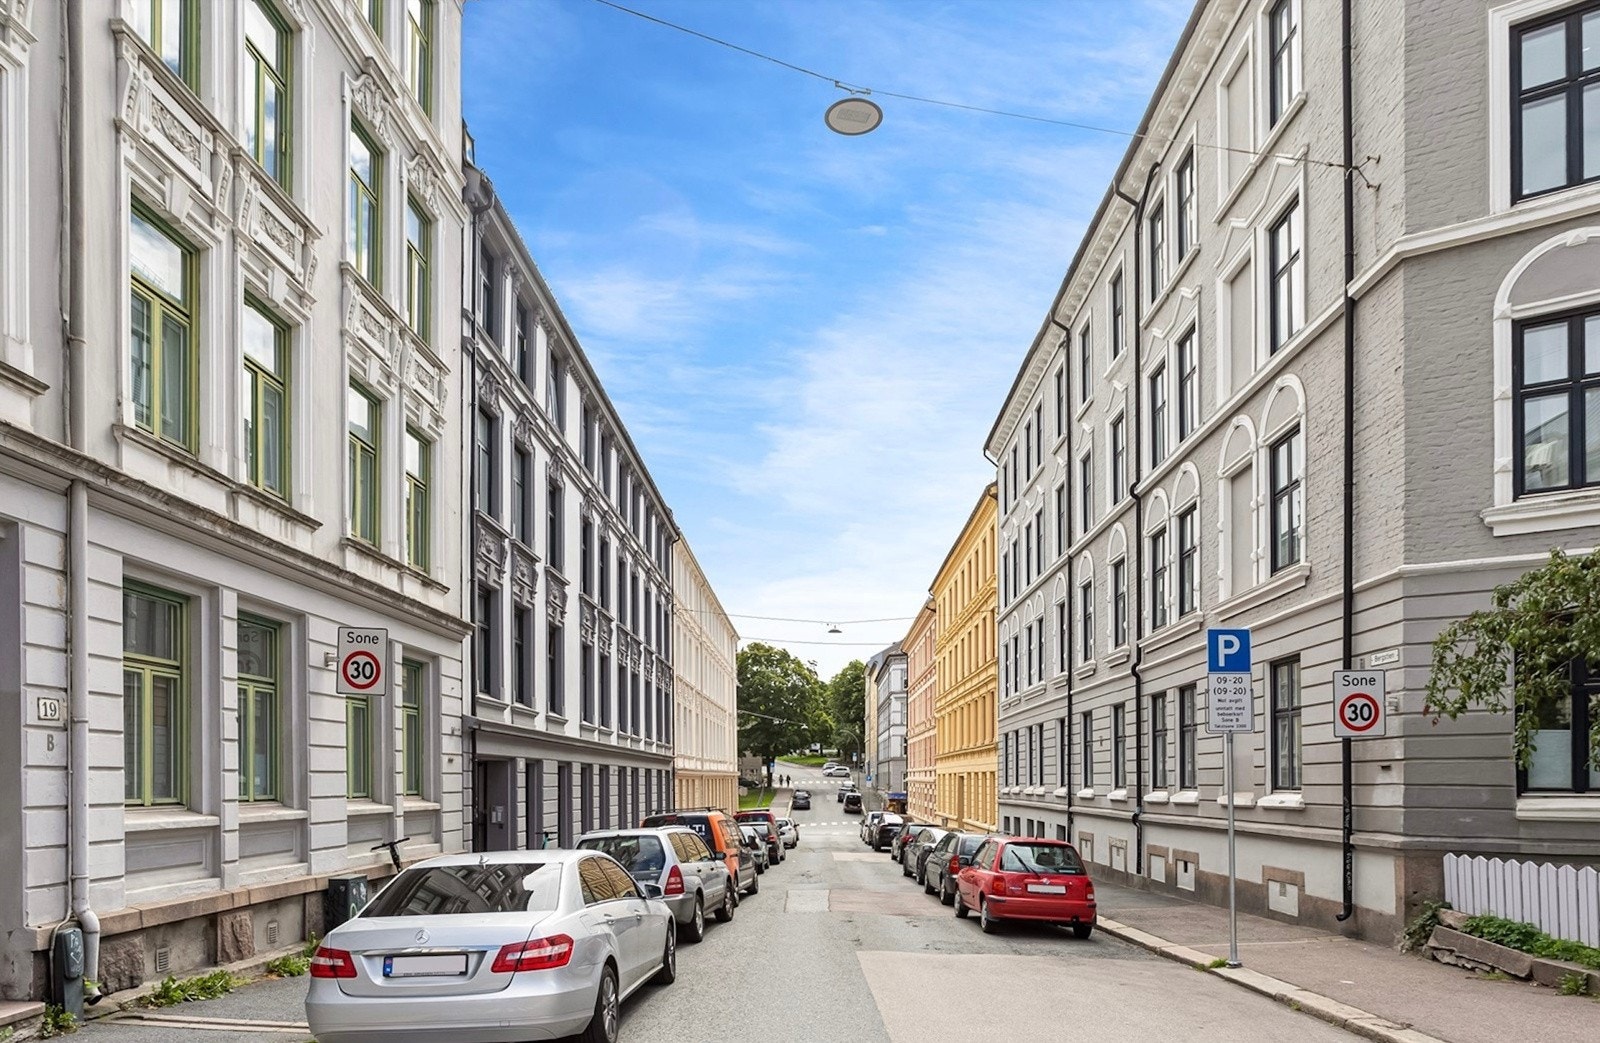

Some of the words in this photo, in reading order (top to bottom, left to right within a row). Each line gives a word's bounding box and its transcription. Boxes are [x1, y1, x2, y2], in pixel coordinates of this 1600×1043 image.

[347, 631, 379, 645] Sone
[1218, 634, 1240, 667] P
[350, 660, 375, 680] 30
[1342, 675, 1376, 687] Sone
[42, 701, 57, 718] 19
[1347, 703, 1373, 722] 30
[47, 734, 55, 751] B
